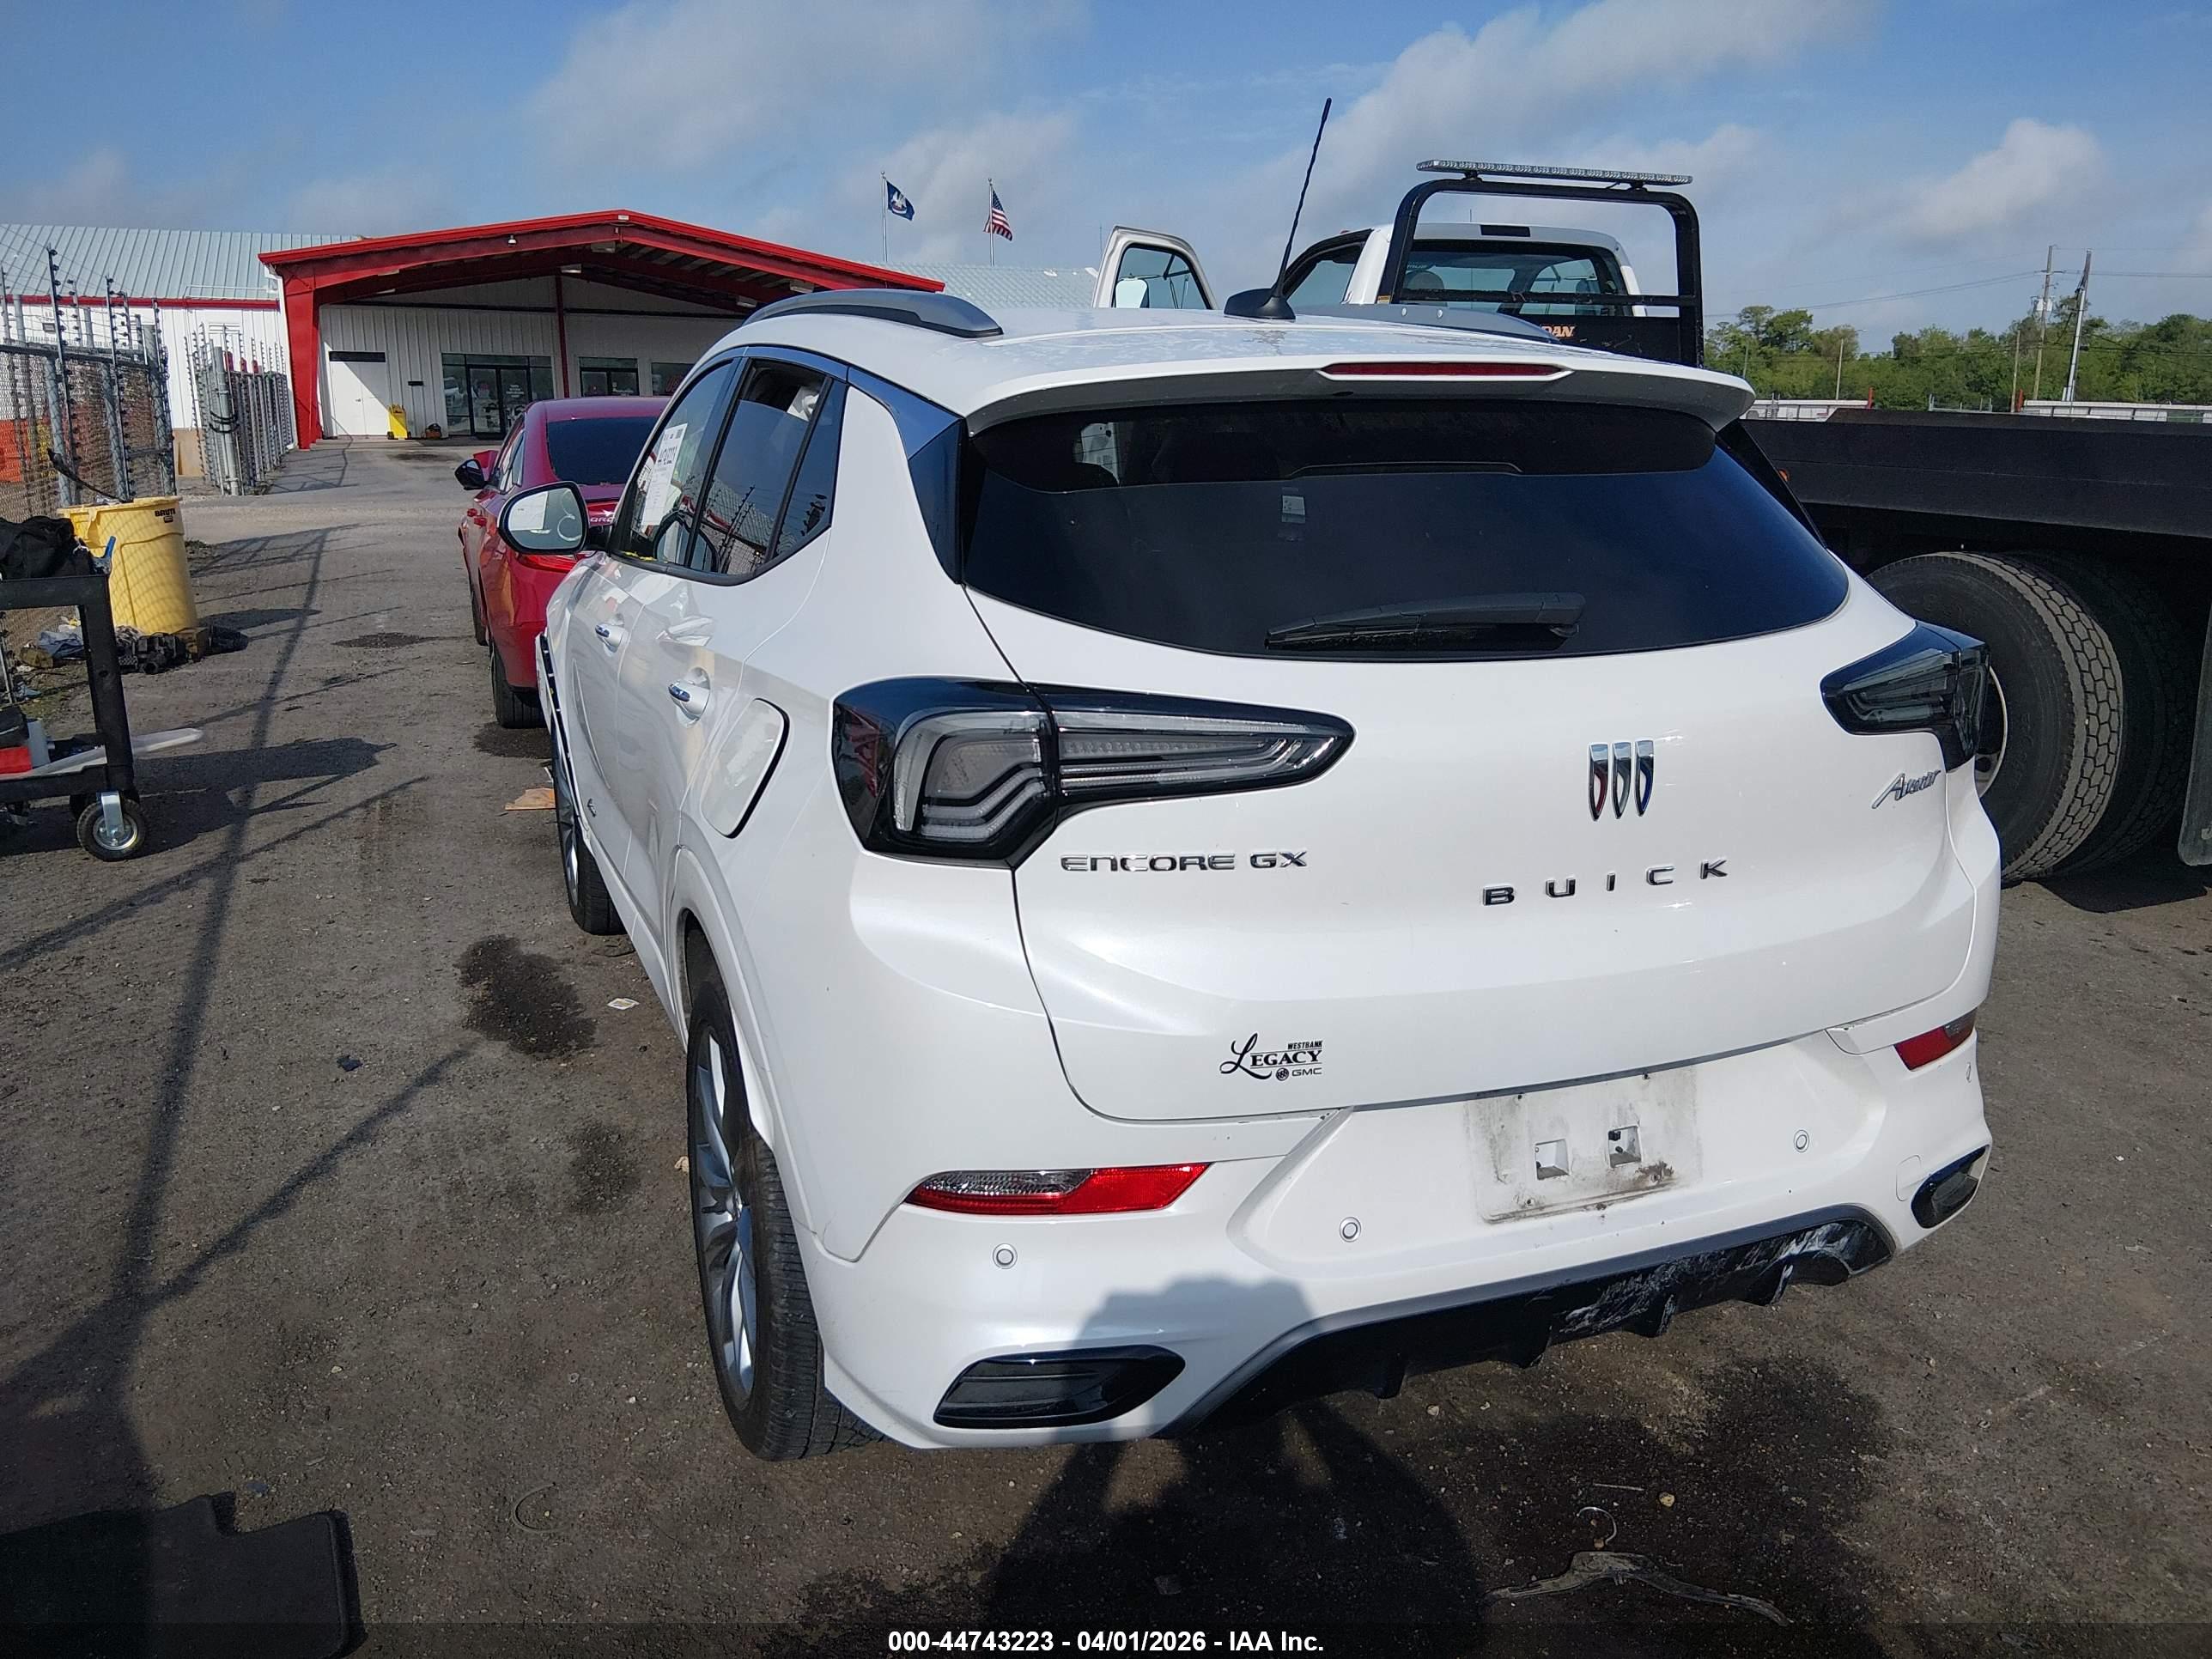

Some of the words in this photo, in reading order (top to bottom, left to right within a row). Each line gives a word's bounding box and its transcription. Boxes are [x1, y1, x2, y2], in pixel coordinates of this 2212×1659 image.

[1060, 854, 1235, 872] ENCORE
[1249, 850, 1307, 868] GX
[1483, 859, 1728, 905] BUICK
[1219, 1032, 1322, 1080] LEGACY
[1287, 1040, 1322, 1050] WESTBANK
[1291, 1067, 1322, 1077] GMC
